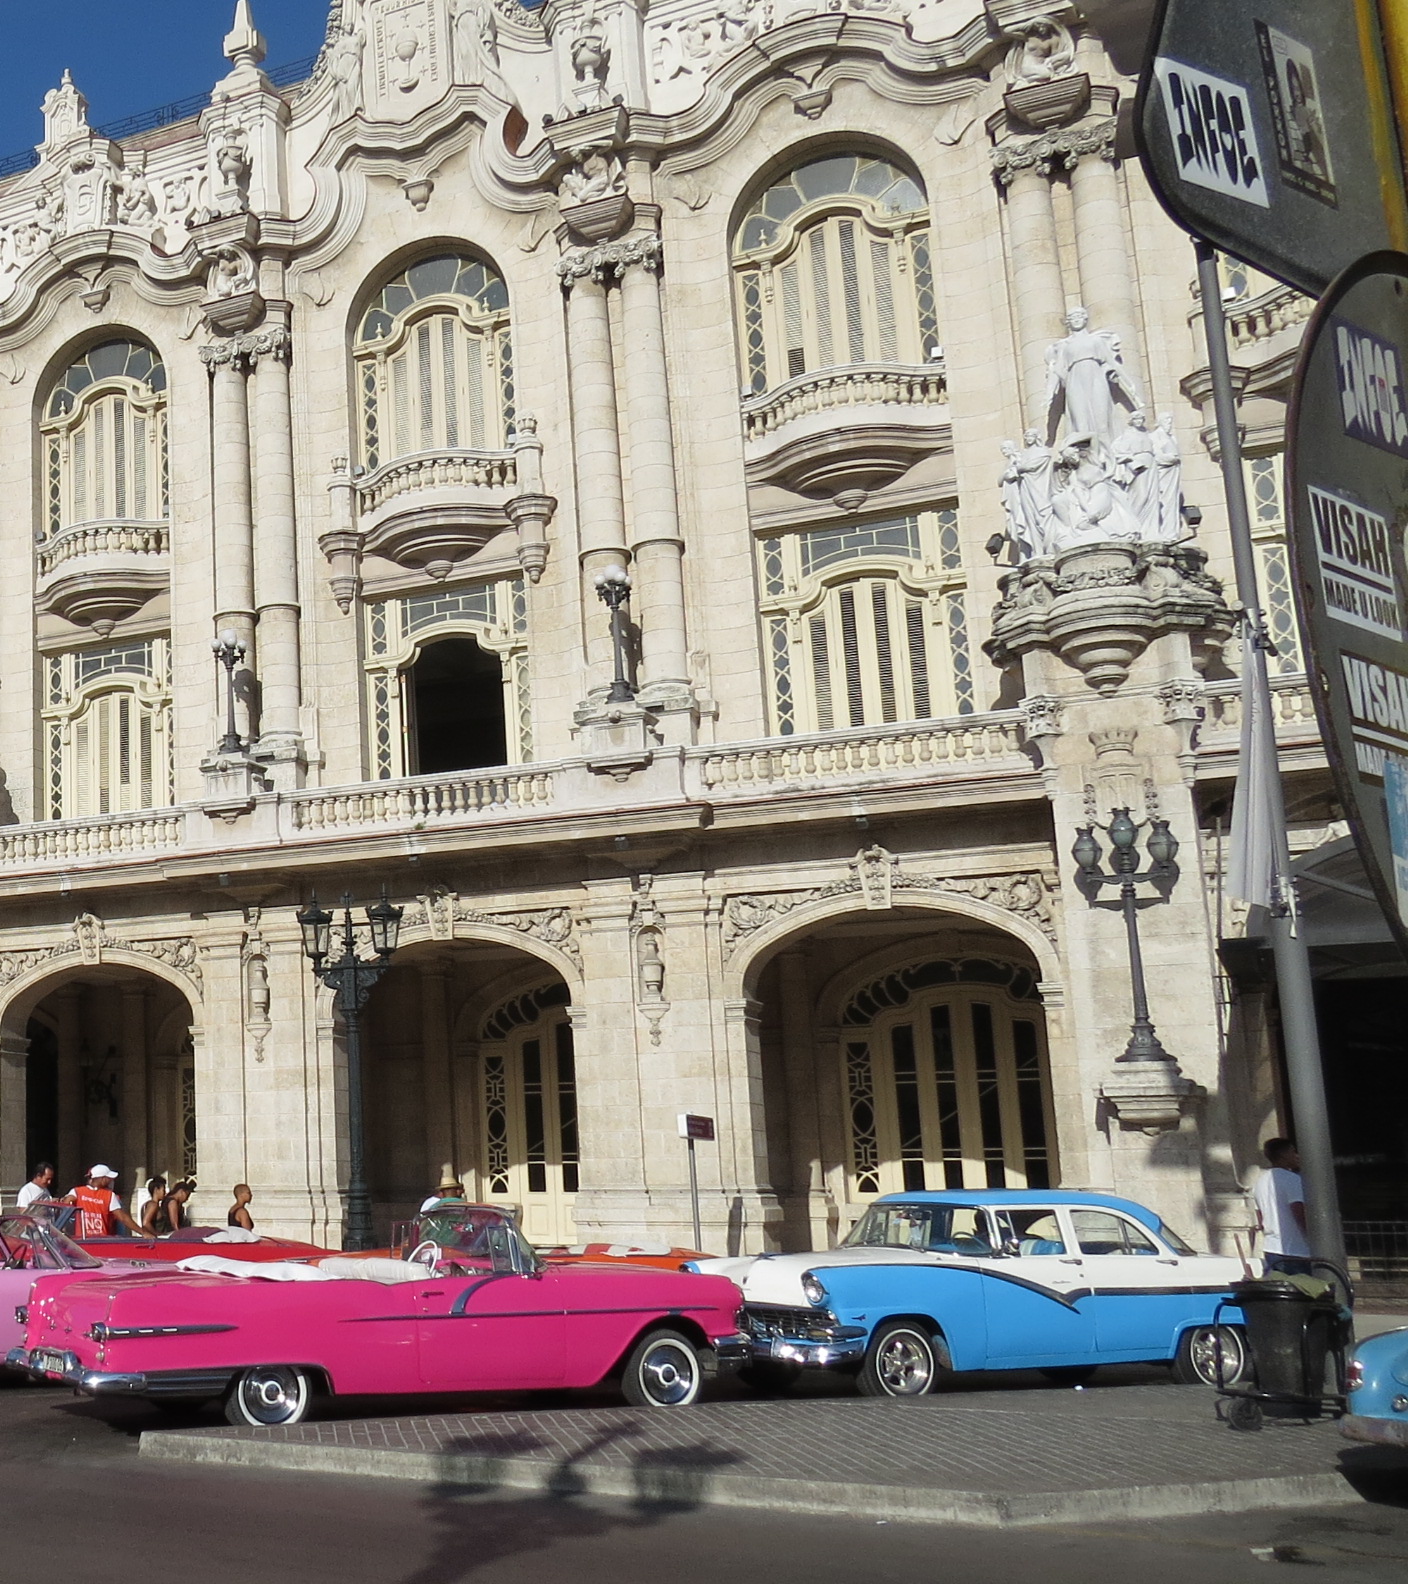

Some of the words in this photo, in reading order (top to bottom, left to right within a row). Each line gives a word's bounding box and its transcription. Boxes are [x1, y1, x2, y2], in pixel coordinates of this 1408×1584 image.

[1311, 492, 1391, 579] VISAH
[1323, 576, 1359, 616] MADE
[1358, 590, 1369, 619] U
[1368, 593, 1401, 631] LOOK
